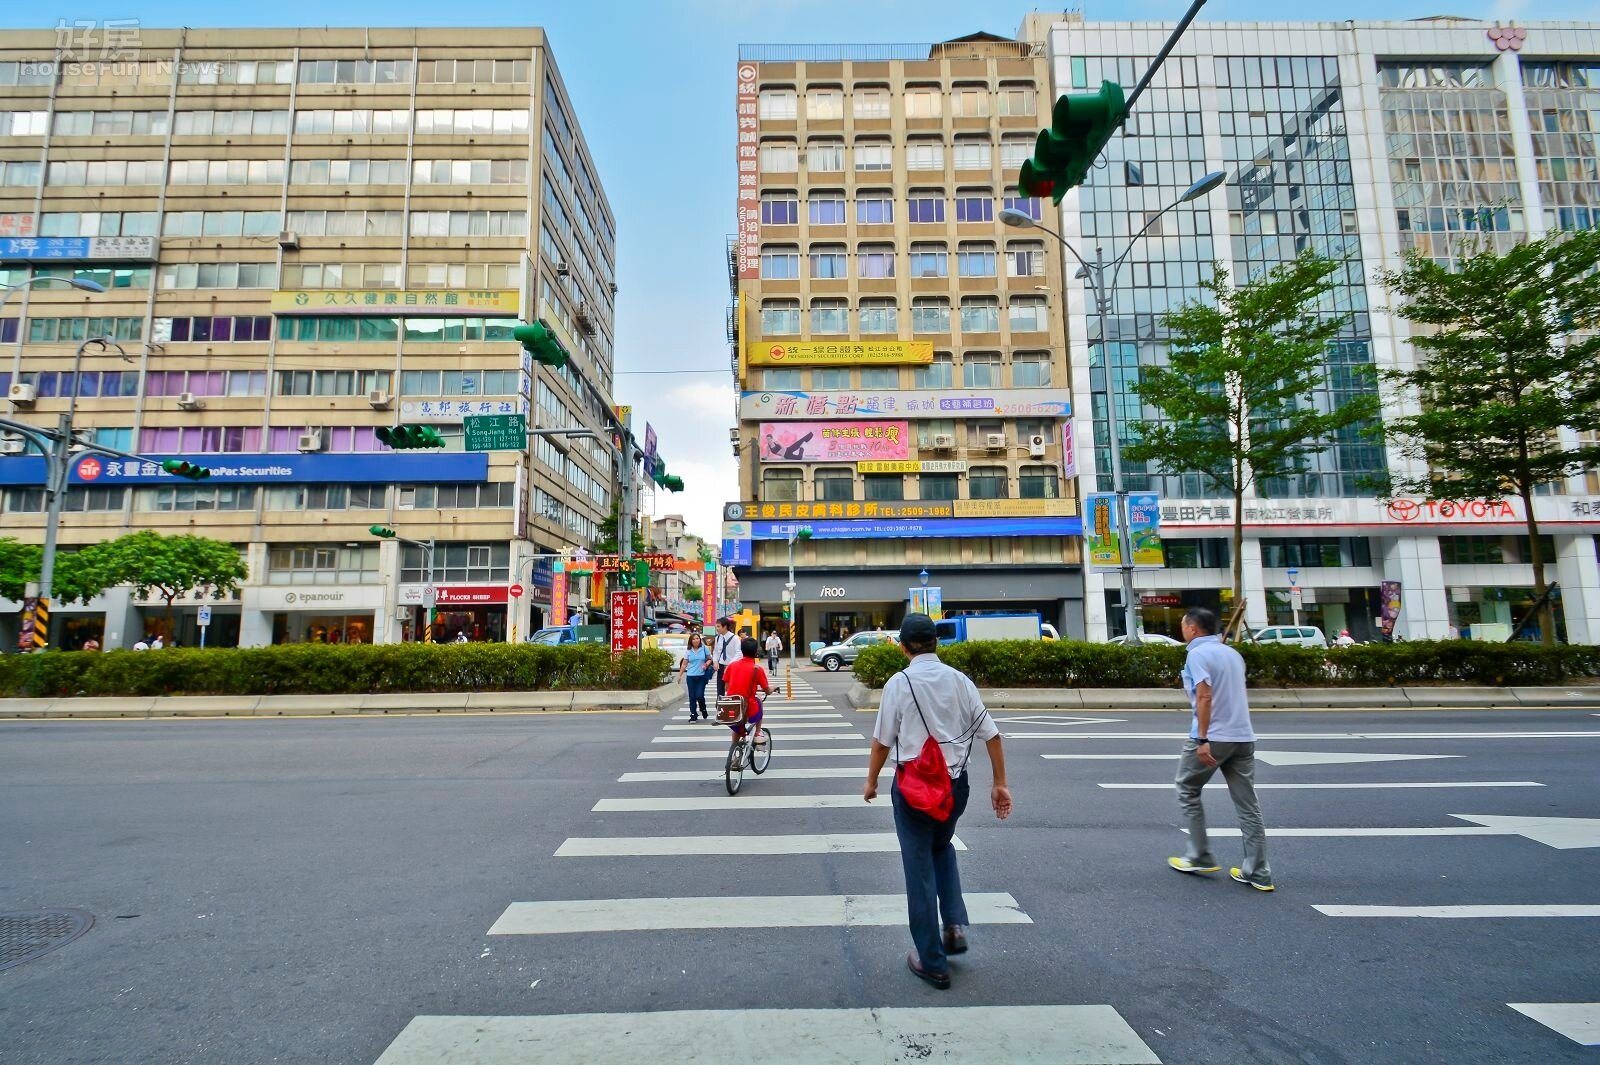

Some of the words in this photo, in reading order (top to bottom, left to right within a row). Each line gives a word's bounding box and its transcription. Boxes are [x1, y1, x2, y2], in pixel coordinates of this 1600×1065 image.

[739, 206, 747, 272] 25165988
[324, 292, 458, 305] 久久健康自然館
[470, 416, 519, 428] 松江路
[240, 466, 292, 476] Securities
[745, 503, 877, 517] 王俊民皮膚科診所
[1244, 507, 1333, 520] 南松江營業所
[1425, 501, 1516, 518] TOYOTA
